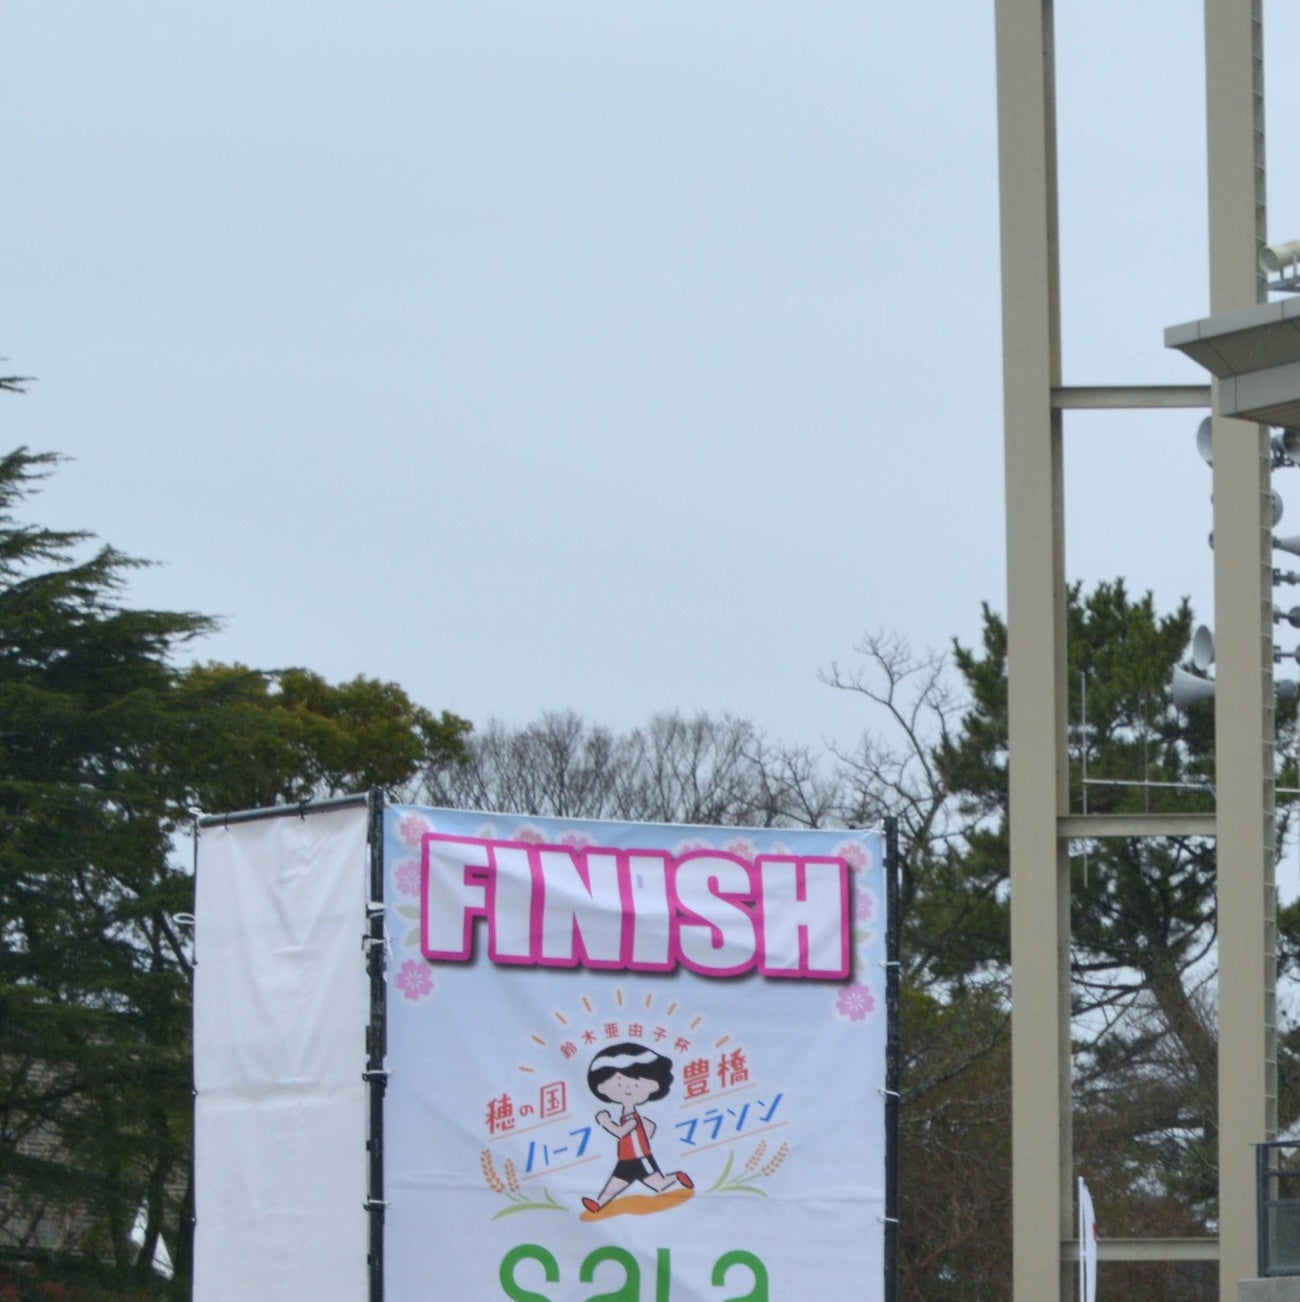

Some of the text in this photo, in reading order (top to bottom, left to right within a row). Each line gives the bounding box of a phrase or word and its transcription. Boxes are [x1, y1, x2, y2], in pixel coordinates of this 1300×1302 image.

[421, 832, 851, 980] FINISH
[560, 1022, 692, 1060] 鈴木亜由子杯
[486, 1047, 751, 1134] 穂の国 豊橋
[525, 1093, 783, 1173] ハーフ マラソン
